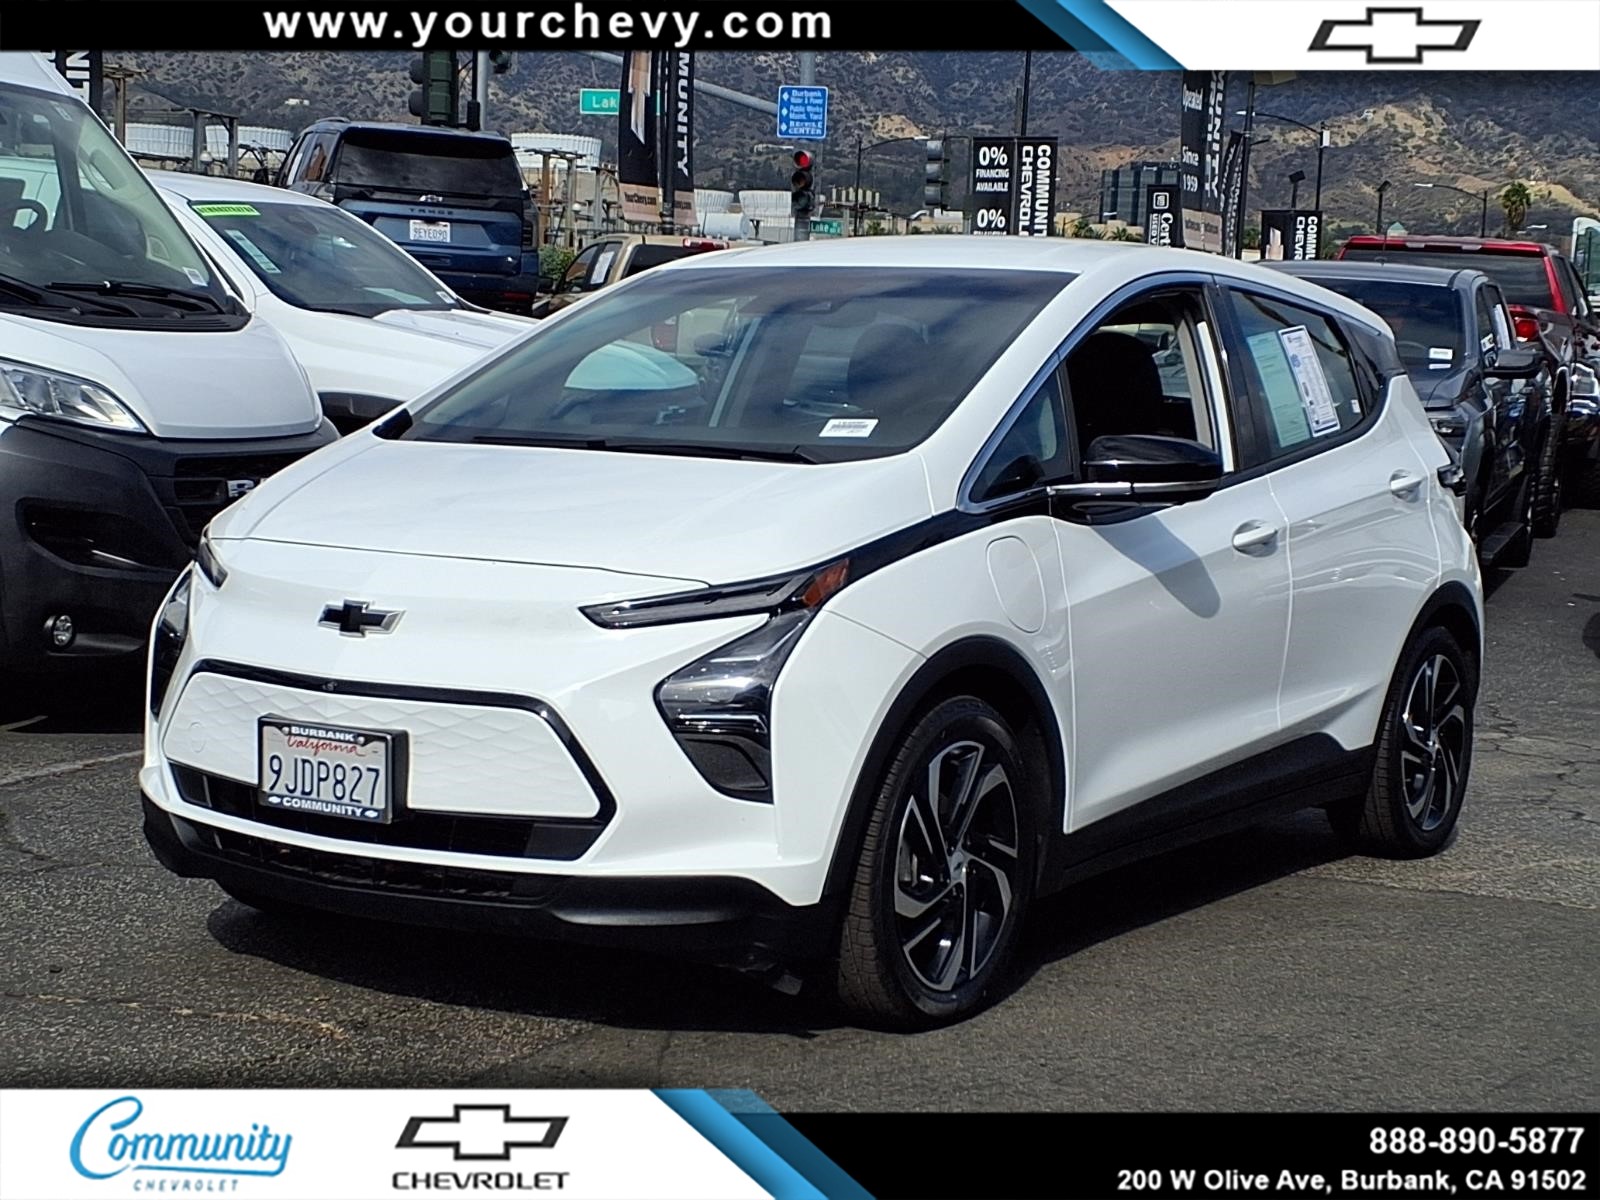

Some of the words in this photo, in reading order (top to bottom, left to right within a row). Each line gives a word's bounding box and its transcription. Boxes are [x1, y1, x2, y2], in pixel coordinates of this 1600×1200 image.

[1182, 83, 1203, 112] Operated
[979, 146, 1008, 166] 0%
[1182, 146, 1199, 166] Since
[976, 168, 1010, 178] FINANCING
[1183, 174, 1198, 192] 1959
[976, 182, 1009, 192] AVAILABLE
[977, 208, 1006, 228] 0%
[291, 726, 355, 742] BURBANK
[286, 734, 367, 757] California
[269, 754, 380, 806] 9JDP827
[282, 797, 364, 817] COMMUNITY
